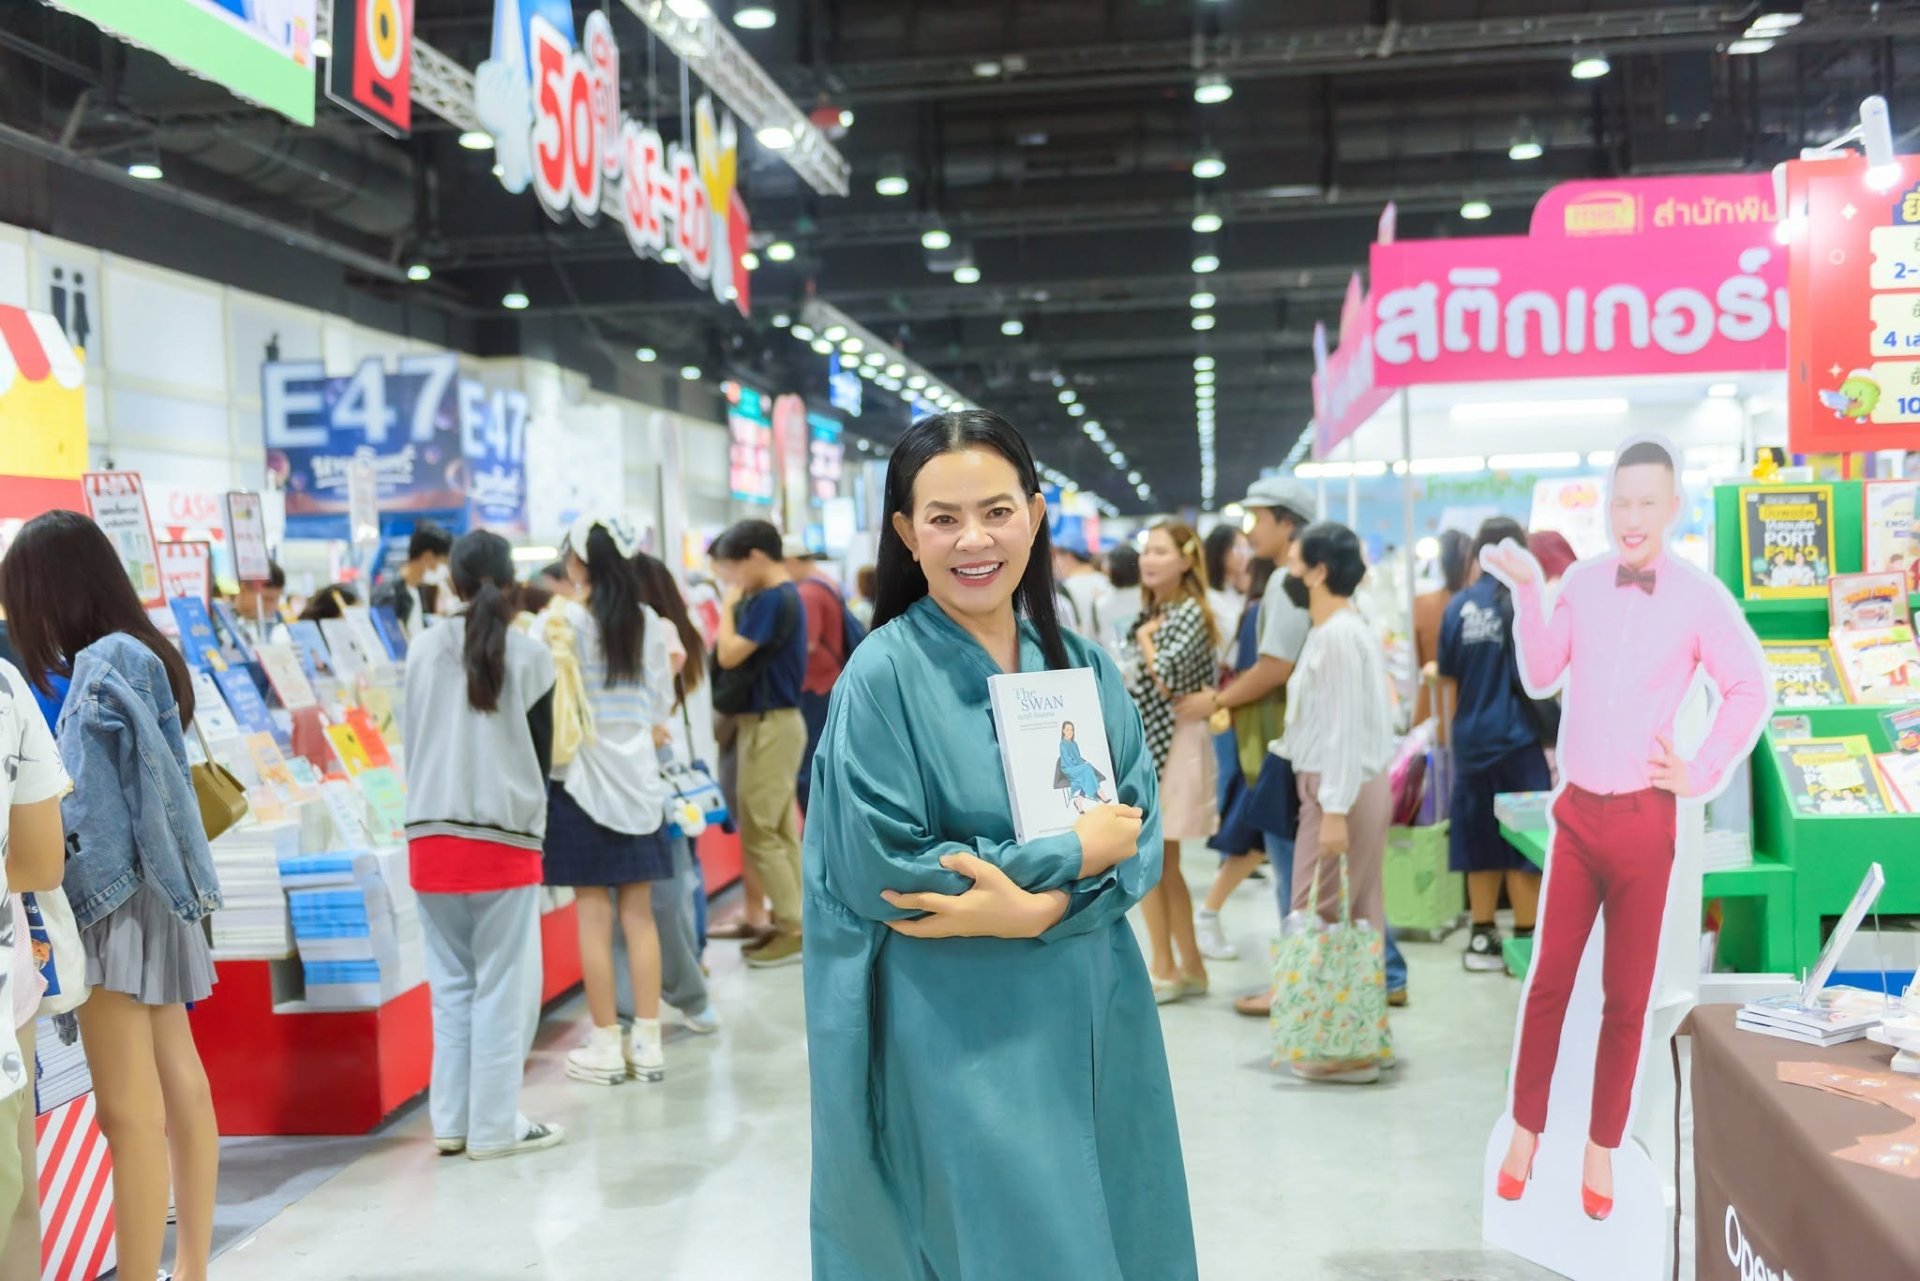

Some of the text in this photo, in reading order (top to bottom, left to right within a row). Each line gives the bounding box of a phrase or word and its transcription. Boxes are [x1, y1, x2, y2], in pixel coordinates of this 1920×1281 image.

[536, 33, 596, 201] 50
[264, 352, 458, 449] E47
[459, 378, 529, 465] E47
[1764, 530, 1816, 547] PORT
[1020, 694, 1065, 712] SWAN
